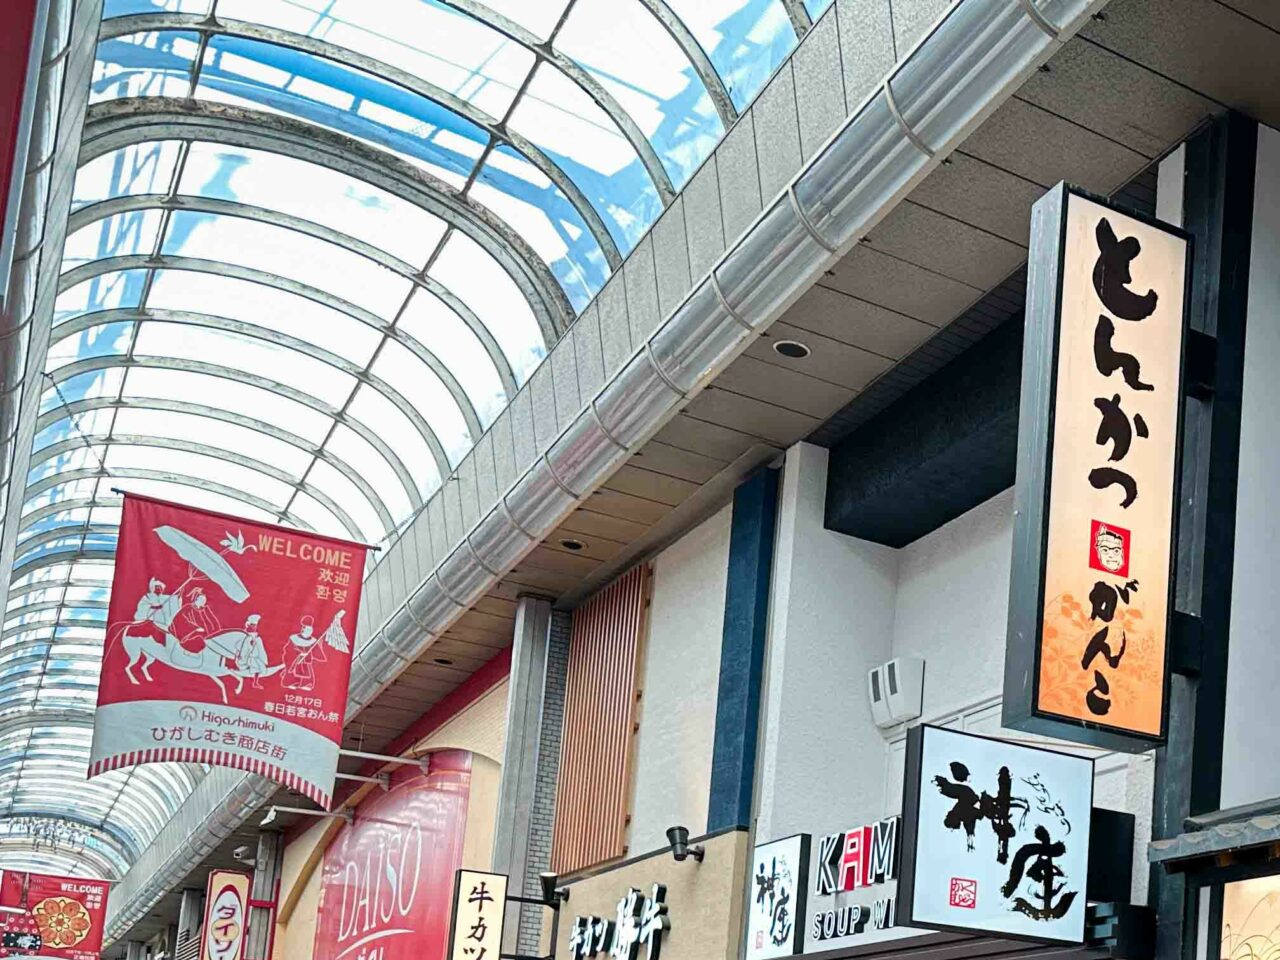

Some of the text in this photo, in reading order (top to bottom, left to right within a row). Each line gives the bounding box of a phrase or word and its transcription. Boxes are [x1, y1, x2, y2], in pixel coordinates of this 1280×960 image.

[1088, 216, 1158, 509] とんかつ
[258, 533, 351, 569] WELCOME
[315, 585, 348, 603] 환영
[318, 568, 350, 586] 欢迎
[1082, 578, 1140, 716] がんこ
[264, 702, 340, 724] 春日若宮おん祭
[284, 693, 323, 708] 12月17日
[201, 709, 275, 733] Higashimuki
[151, 725, 288, 762] ひがしむき商店街
[815, 816, 899, 896] KAM
[931, 761, 1078, 922] 神座
[60, 883, 104, 895] WELCOME
[338, 822, 422, 942] DAISO
[812, 904, 862, 941] SOUP
